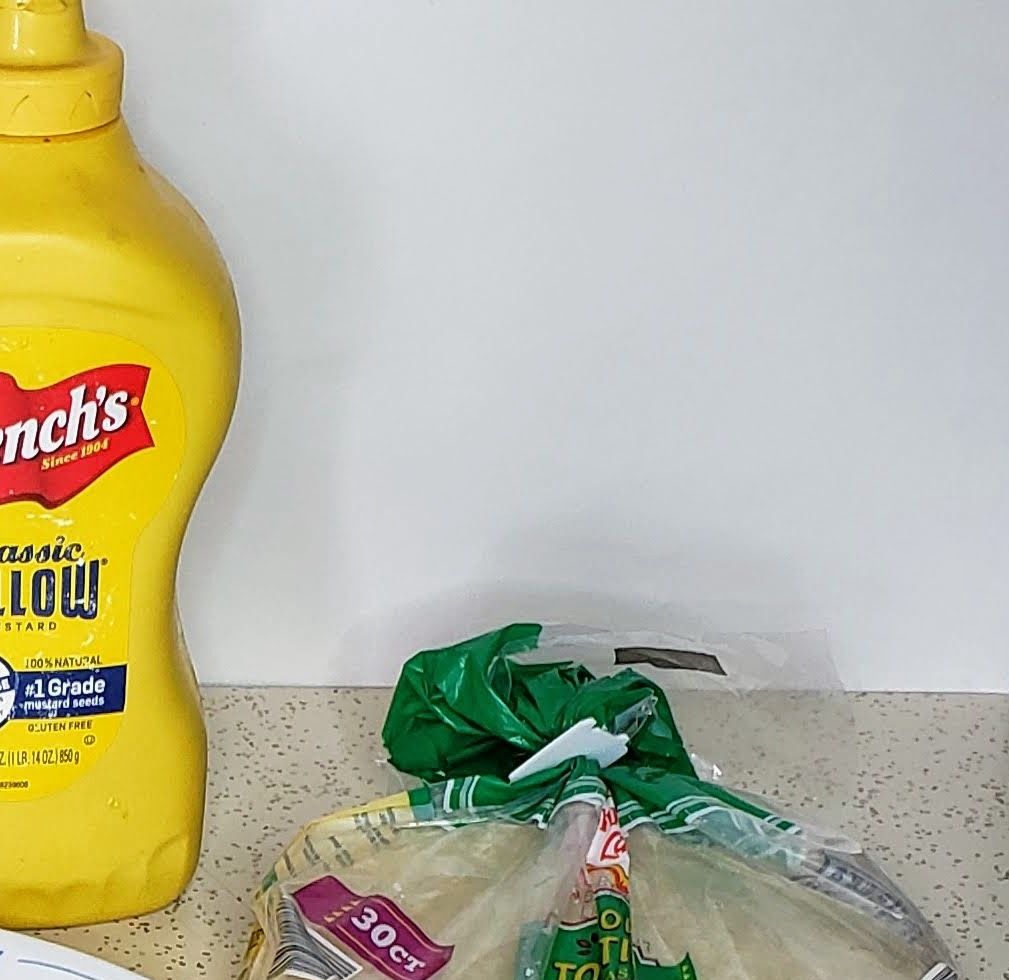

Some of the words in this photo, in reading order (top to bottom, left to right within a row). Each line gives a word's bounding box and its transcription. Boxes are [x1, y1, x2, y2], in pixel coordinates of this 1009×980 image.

[41, 450, 78, 470] Since
[80, 438, 110, 459] 1904
[25, 657, 53, 669] 100%
[24, 678, 46, 699] #1
[47, 675, 106, 697] Grade
[23, 696, 70, 711] mustard
[72, 694, 105, 708] seeds
[68, 719, 93, 730] FREE
[31, 750, 41, 765] 14
[59, 748, 73, 764] 850
[74, 751, 80, 765] g
